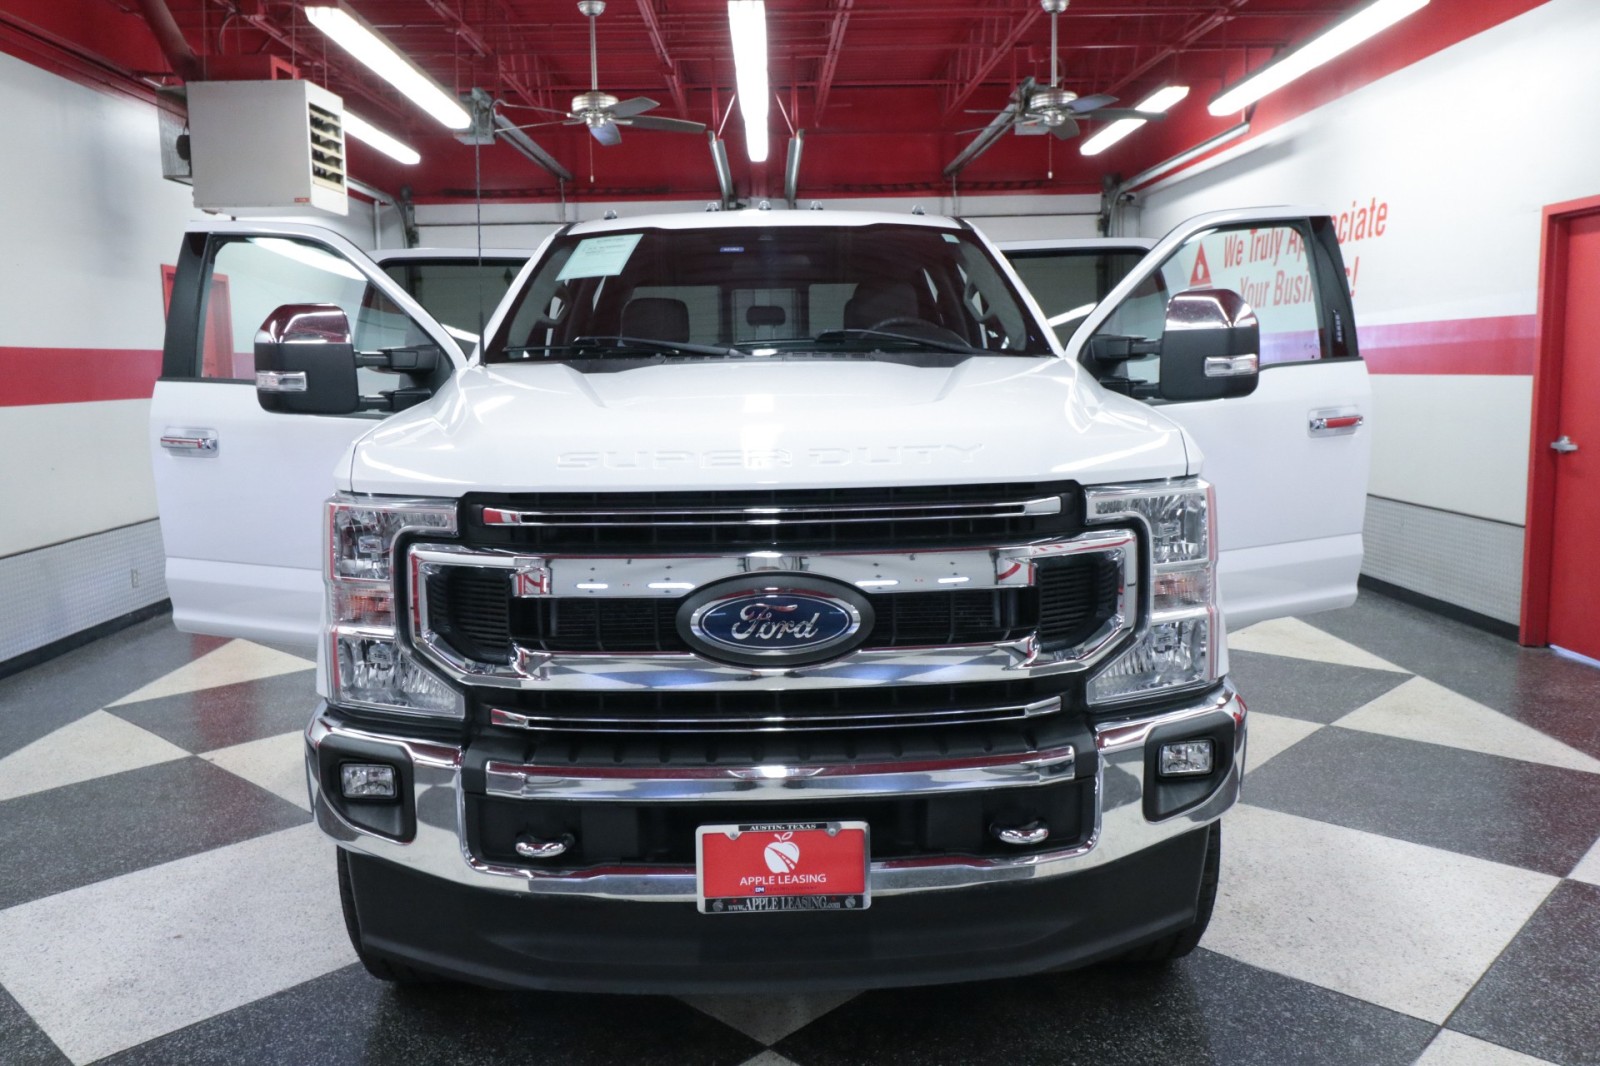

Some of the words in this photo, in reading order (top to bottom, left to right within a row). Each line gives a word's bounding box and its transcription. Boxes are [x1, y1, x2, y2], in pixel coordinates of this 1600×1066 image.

[1224, 233, 1244, 268] We
[1249, 227, 1284, 266] Truly
[1240, 276, 1270, 309] Your
[556, 451, 793, 470] SUPER
[808, 443, 985, 465] DUTY
[731, 603, 820, 640] Ford
[740, 876, 775, 886] APPLE
[778, 874, 827, 884] LEASING
